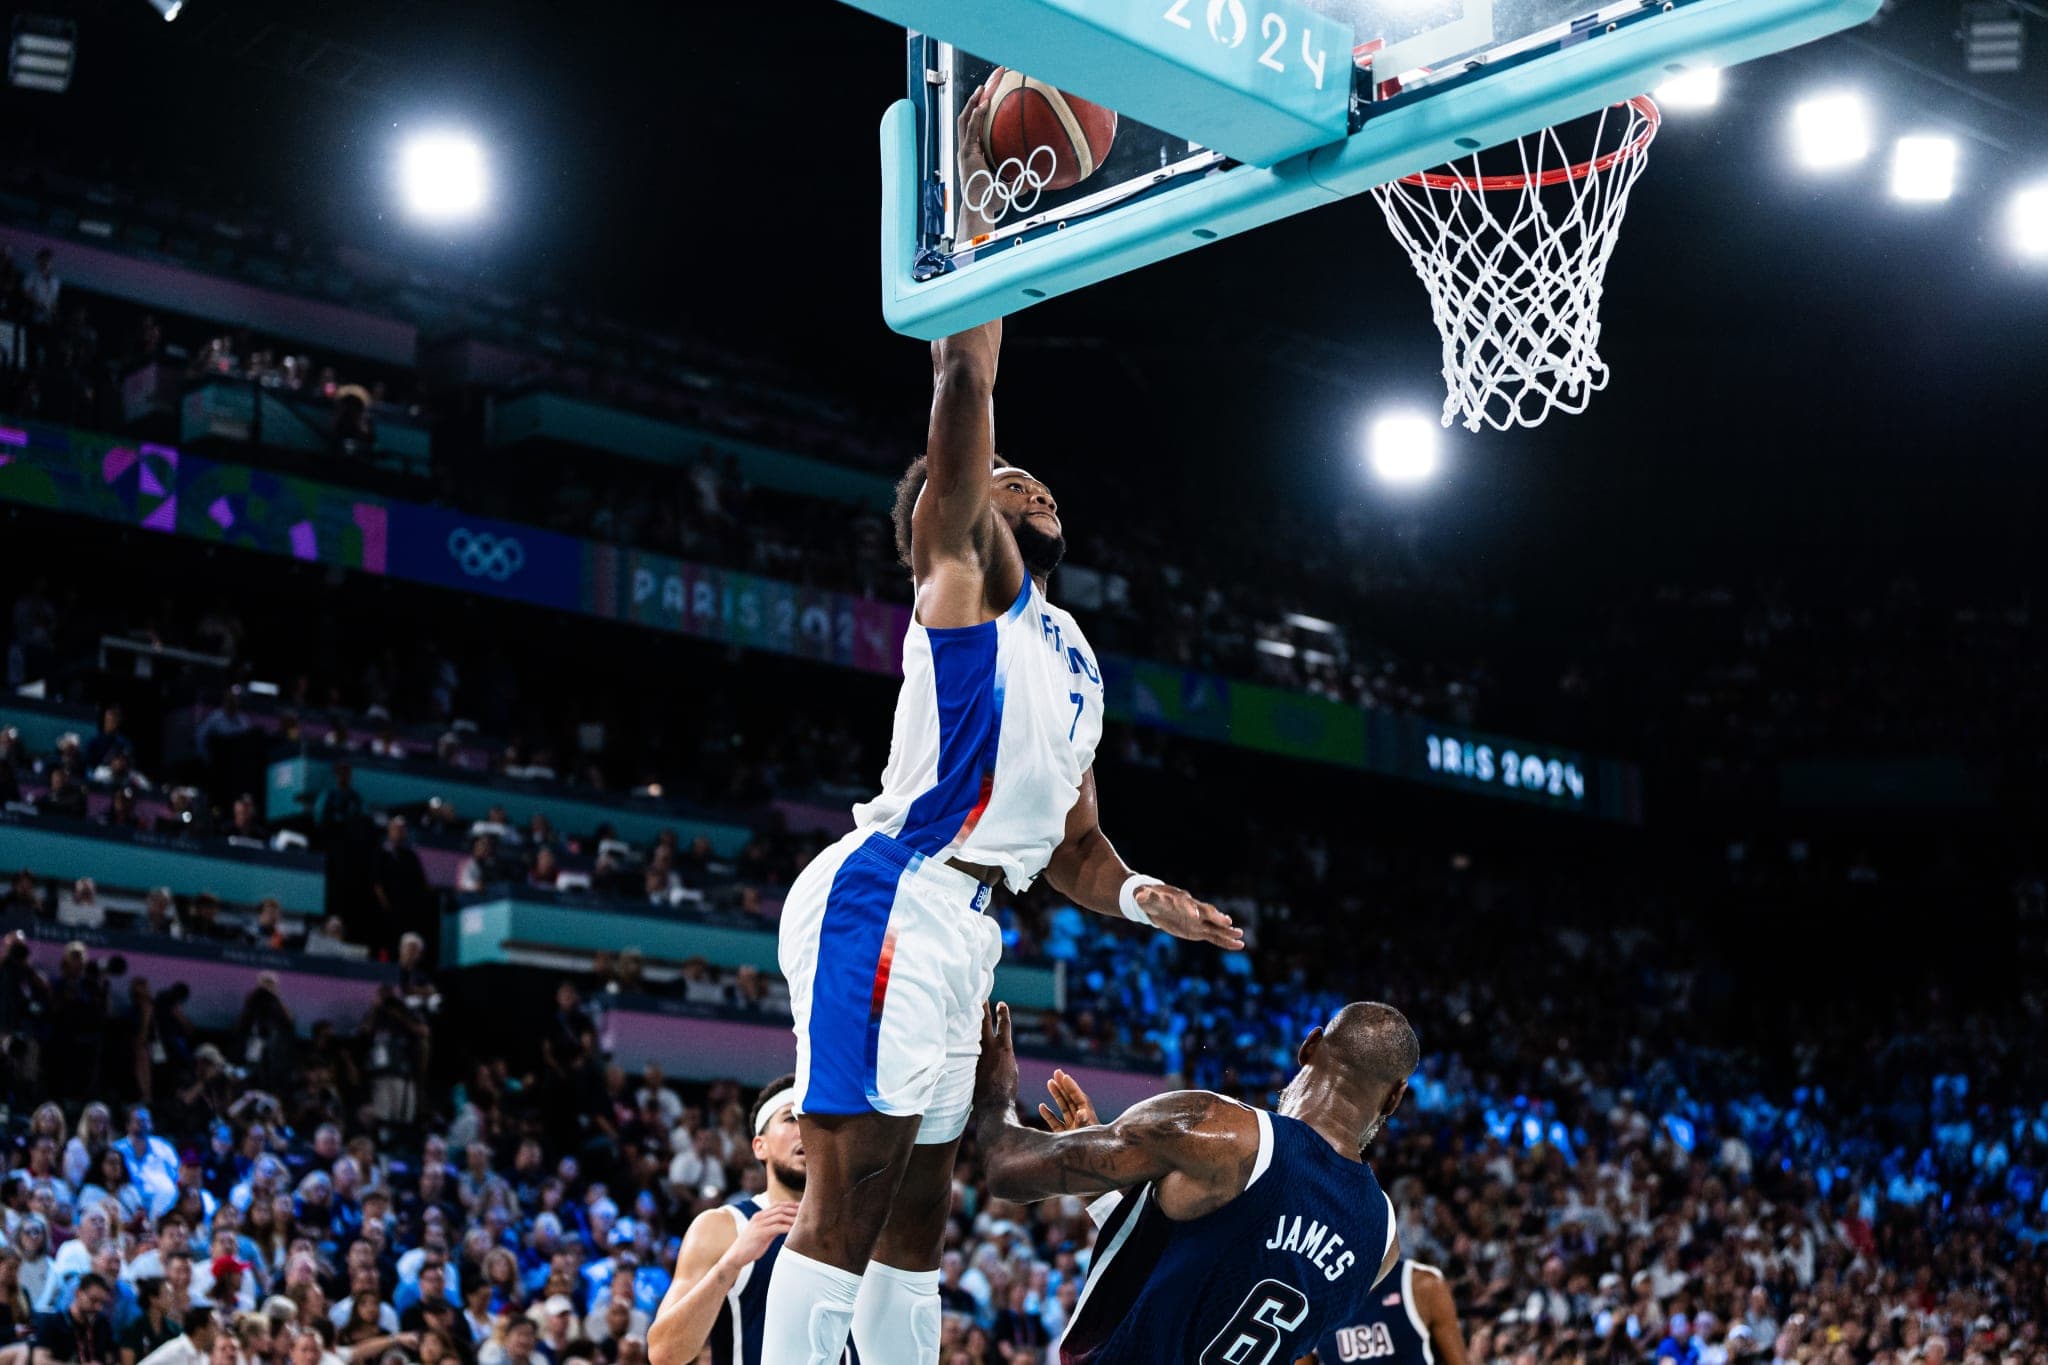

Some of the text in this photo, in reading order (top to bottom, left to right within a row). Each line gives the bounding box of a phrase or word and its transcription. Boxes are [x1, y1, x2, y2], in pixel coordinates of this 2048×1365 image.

[633, 568, 760, 628] PARIS
[1069, 690, 1084, 743] 7
[1502, 749, 1585, 799] 2024
[1266, 1214, 1355, 1282] JAMES
[1199, 1278, 1309, 1365] 6
[1336, 1321, 1395, 1363] USA
